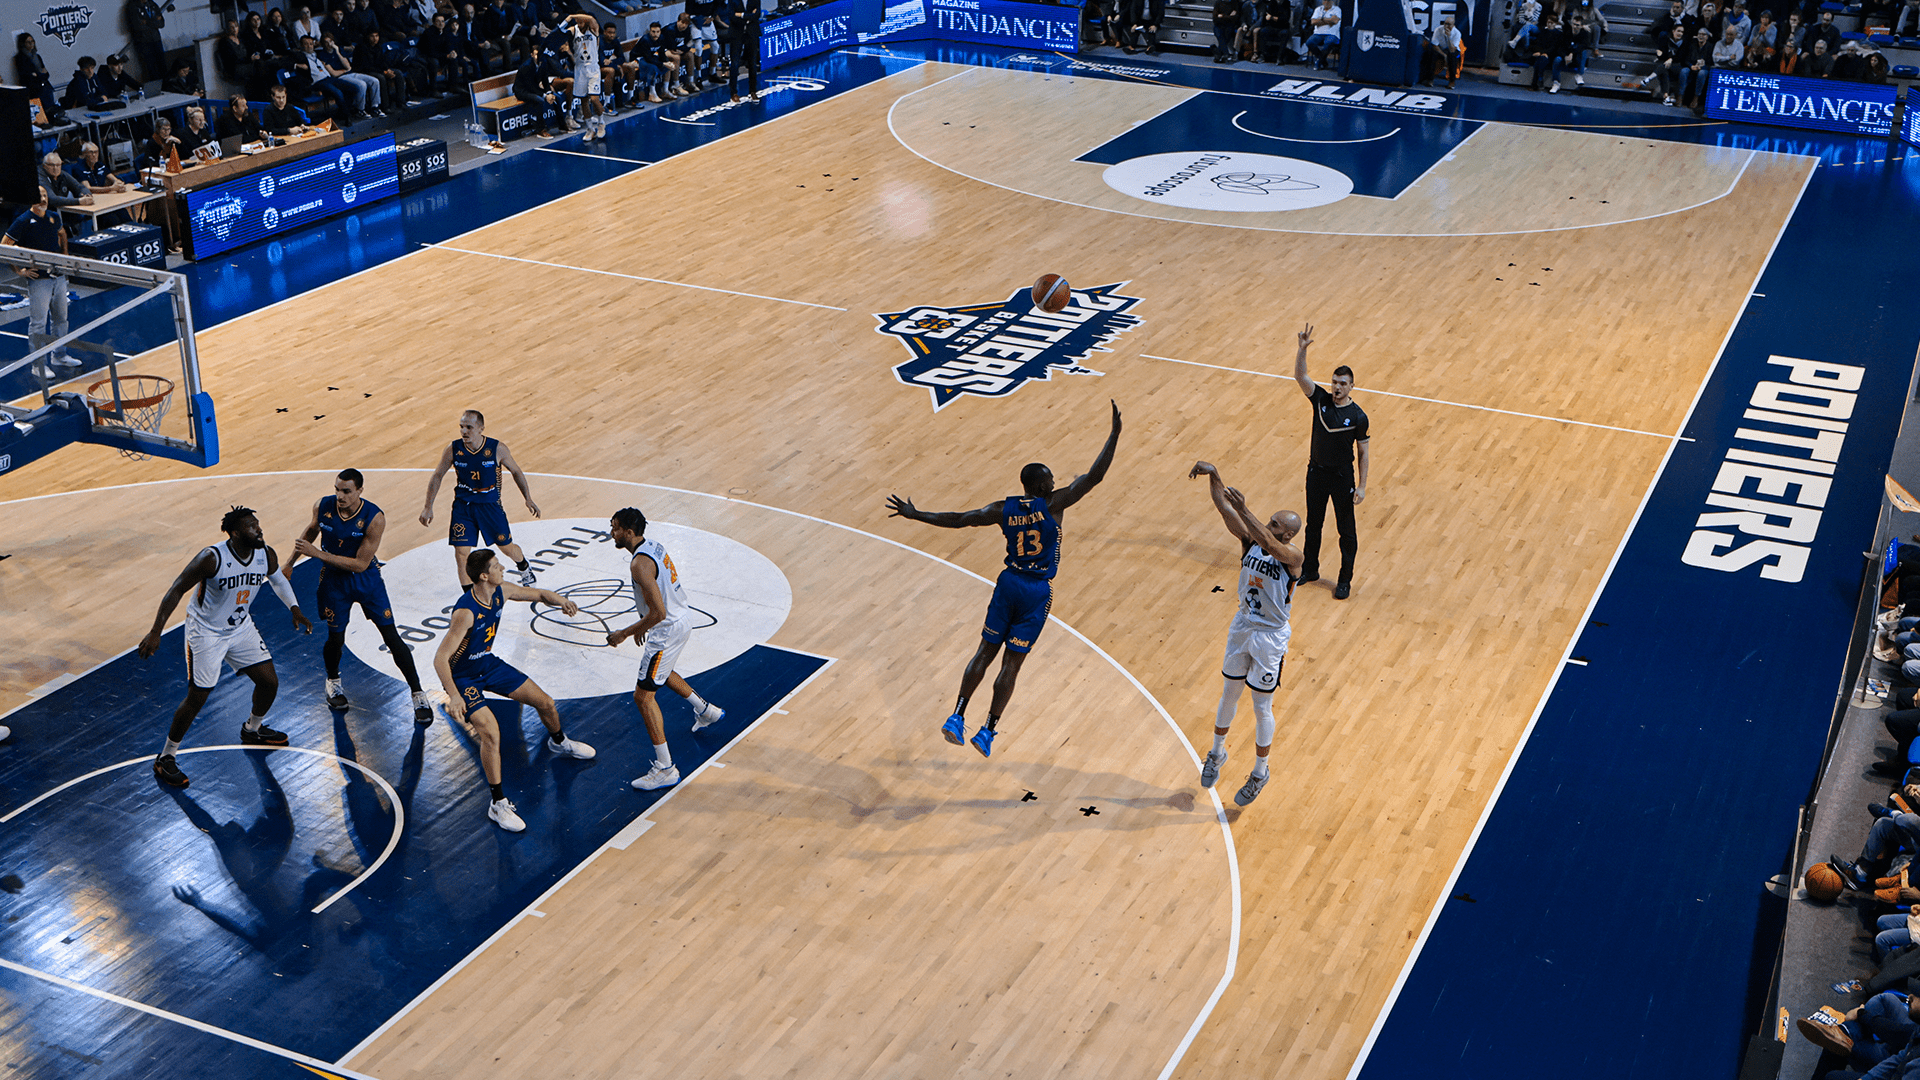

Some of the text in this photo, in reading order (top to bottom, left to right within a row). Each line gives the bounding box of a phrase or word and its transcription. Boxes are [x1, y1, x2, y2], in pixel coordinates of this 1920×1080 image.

[932, 0, 980, 10] MAGAZINE
[41, 8, 89, 31] POITIERS
[932, 8, 1076, 41] TENDANCES
[764, 15, 850, 58] TENDANCES
[1718, 73, 1780, 89] MAGAZINE
[502, 113, 529, 132] CBRE
[403, 159, 421, 176] SOS
[427, 152, 445, 168] SOS
[1143, 153, 1231, 197] futuroscope
[135, 240, 160, 259] SOS
[945, 311, 1018, 352] BASKET
[912, 291, 1128, 393] POITIERS
[470, 470, 481, 480] 21
[1681, 354, 1866, 583] POITIERS
[338, 538, 344, 548] 7
[1016, 529, 1043, 556] 13
[235, 589, 250, 605] 12
